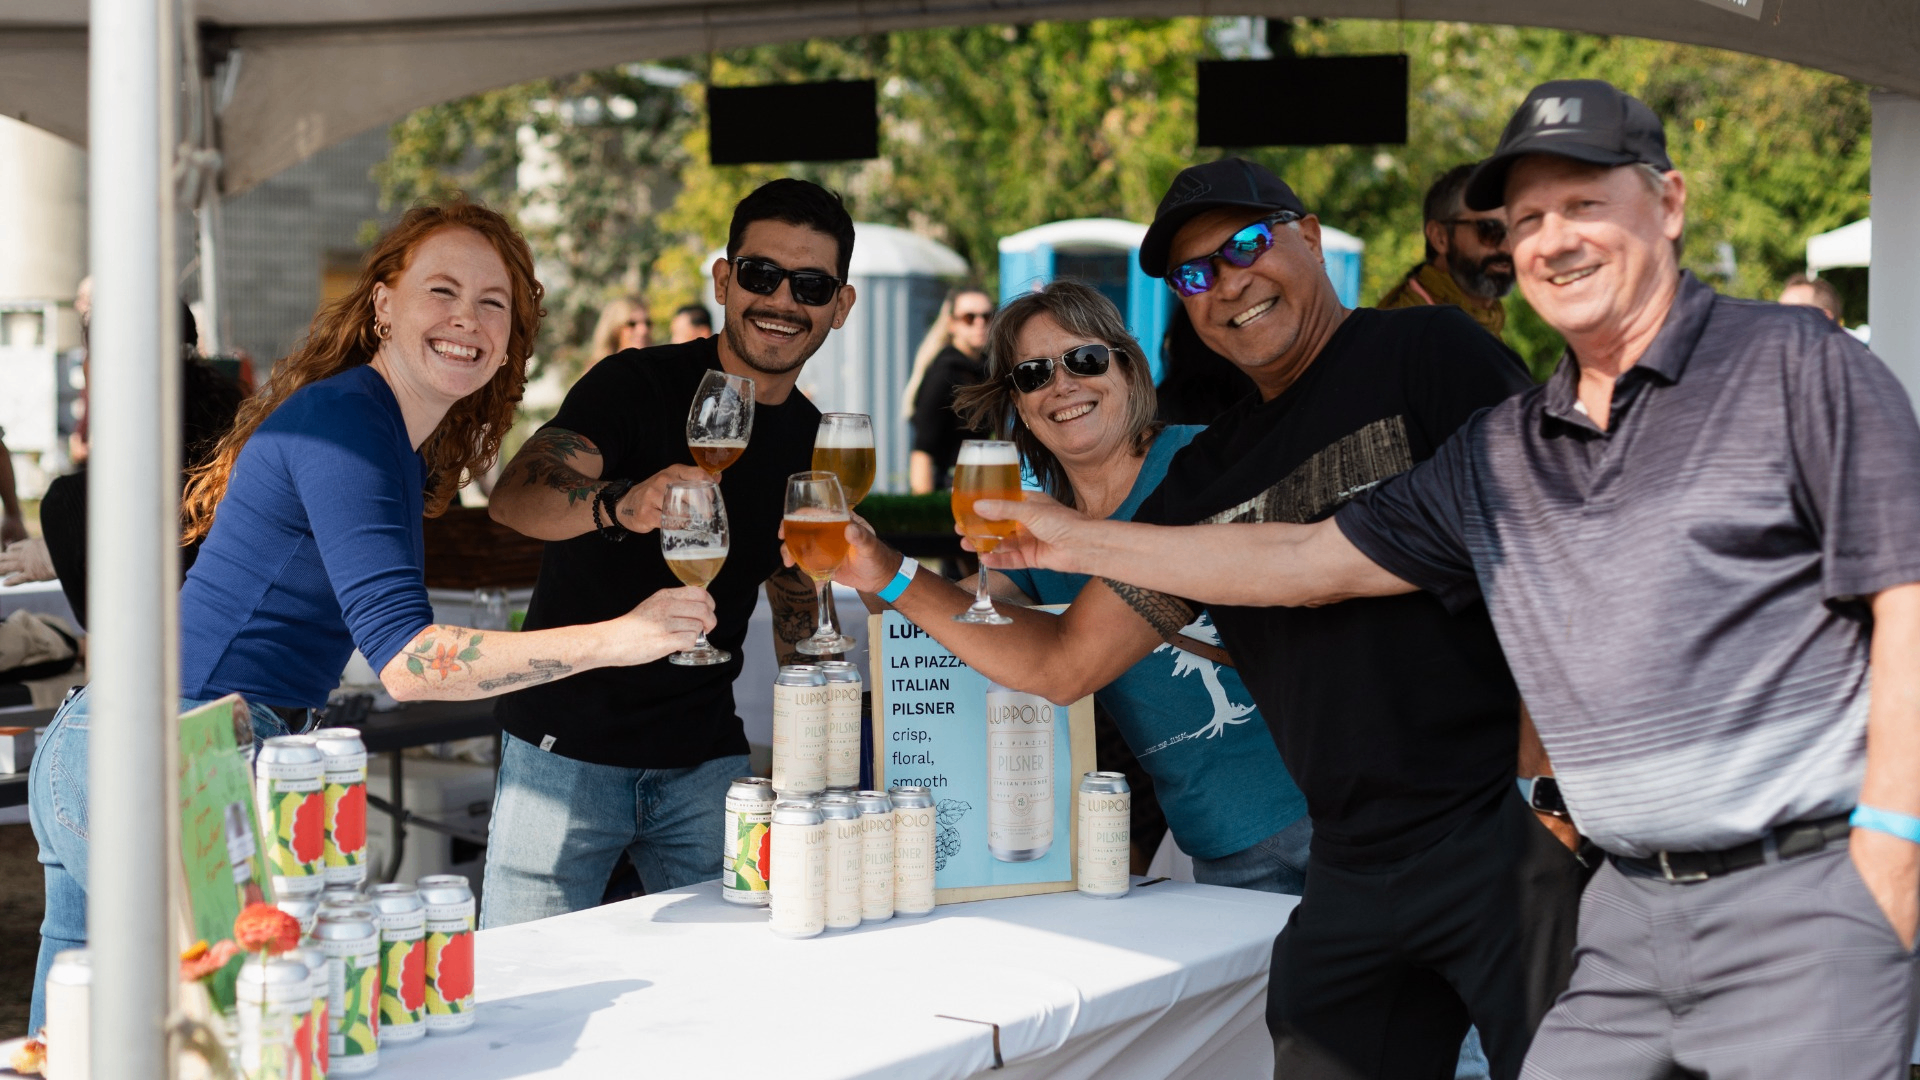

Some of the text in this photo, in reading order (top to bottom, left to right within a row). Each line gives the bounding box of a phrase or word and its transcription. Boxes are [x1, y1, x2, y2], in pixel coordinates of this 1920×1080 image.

[890, 624, 930, 639] LUP
[891, 656, 910, 669] LA
[891, 678, 950, 692] ITALIAN
[892, 701, 955, 716] PILSNER
[989, 704, 1052, 725] LUPPOLO
[892, 728, 932, 744] crisp,
[892, 750, 935, 766] floral,
[998, 754, 1044, 772] PILSNER
[892, 773, 948, 787] smooth
